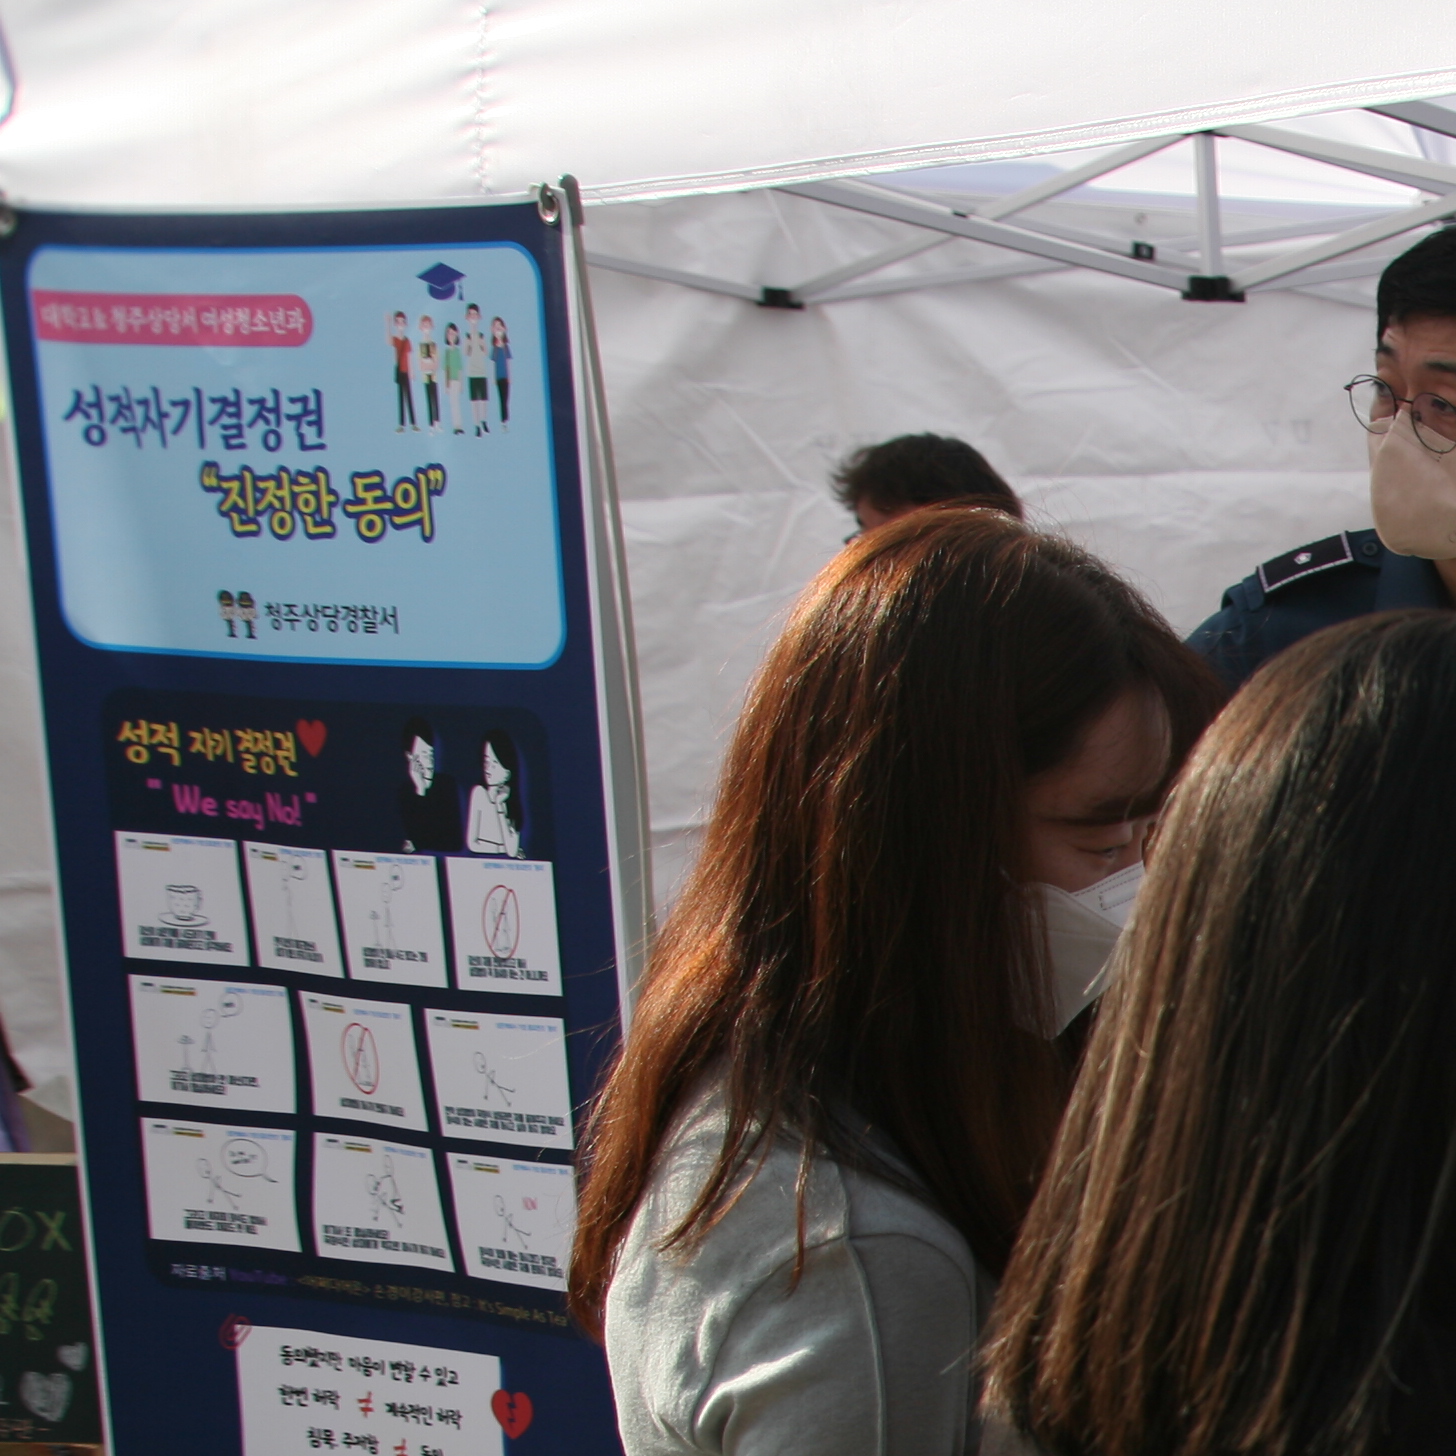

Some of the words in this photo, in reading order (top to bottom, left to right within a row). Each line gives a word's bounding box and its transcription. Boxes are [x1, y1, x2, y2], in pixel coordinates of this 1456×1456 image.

[201, 305, 306, 335] 여성청소년과
[61, 383, 327, 453] 성적자기결정권
[265, 602, 400, 634] 청주상당경찰서
[117, 719, 182, 767] 성적
[187, 727, 235, 763] 자기
[234, 729, 299, 777] 결정권
[172, 783, 219, 817] We
[225, 800, 265, 831] say
[532, 1308, 547, 1323] As
[347, 1355, 386, 1377] 마음이
[418, 1366, 432, 1381] 수
[435, 1366, 459, 1387] 있고
[278, 1384, 309, 1407] 한번
[312, 1388, 341, 1409] 허락
[384, 1402, 433, 1426] 계속적인
[435, 1408, 463, 1430] 허락
